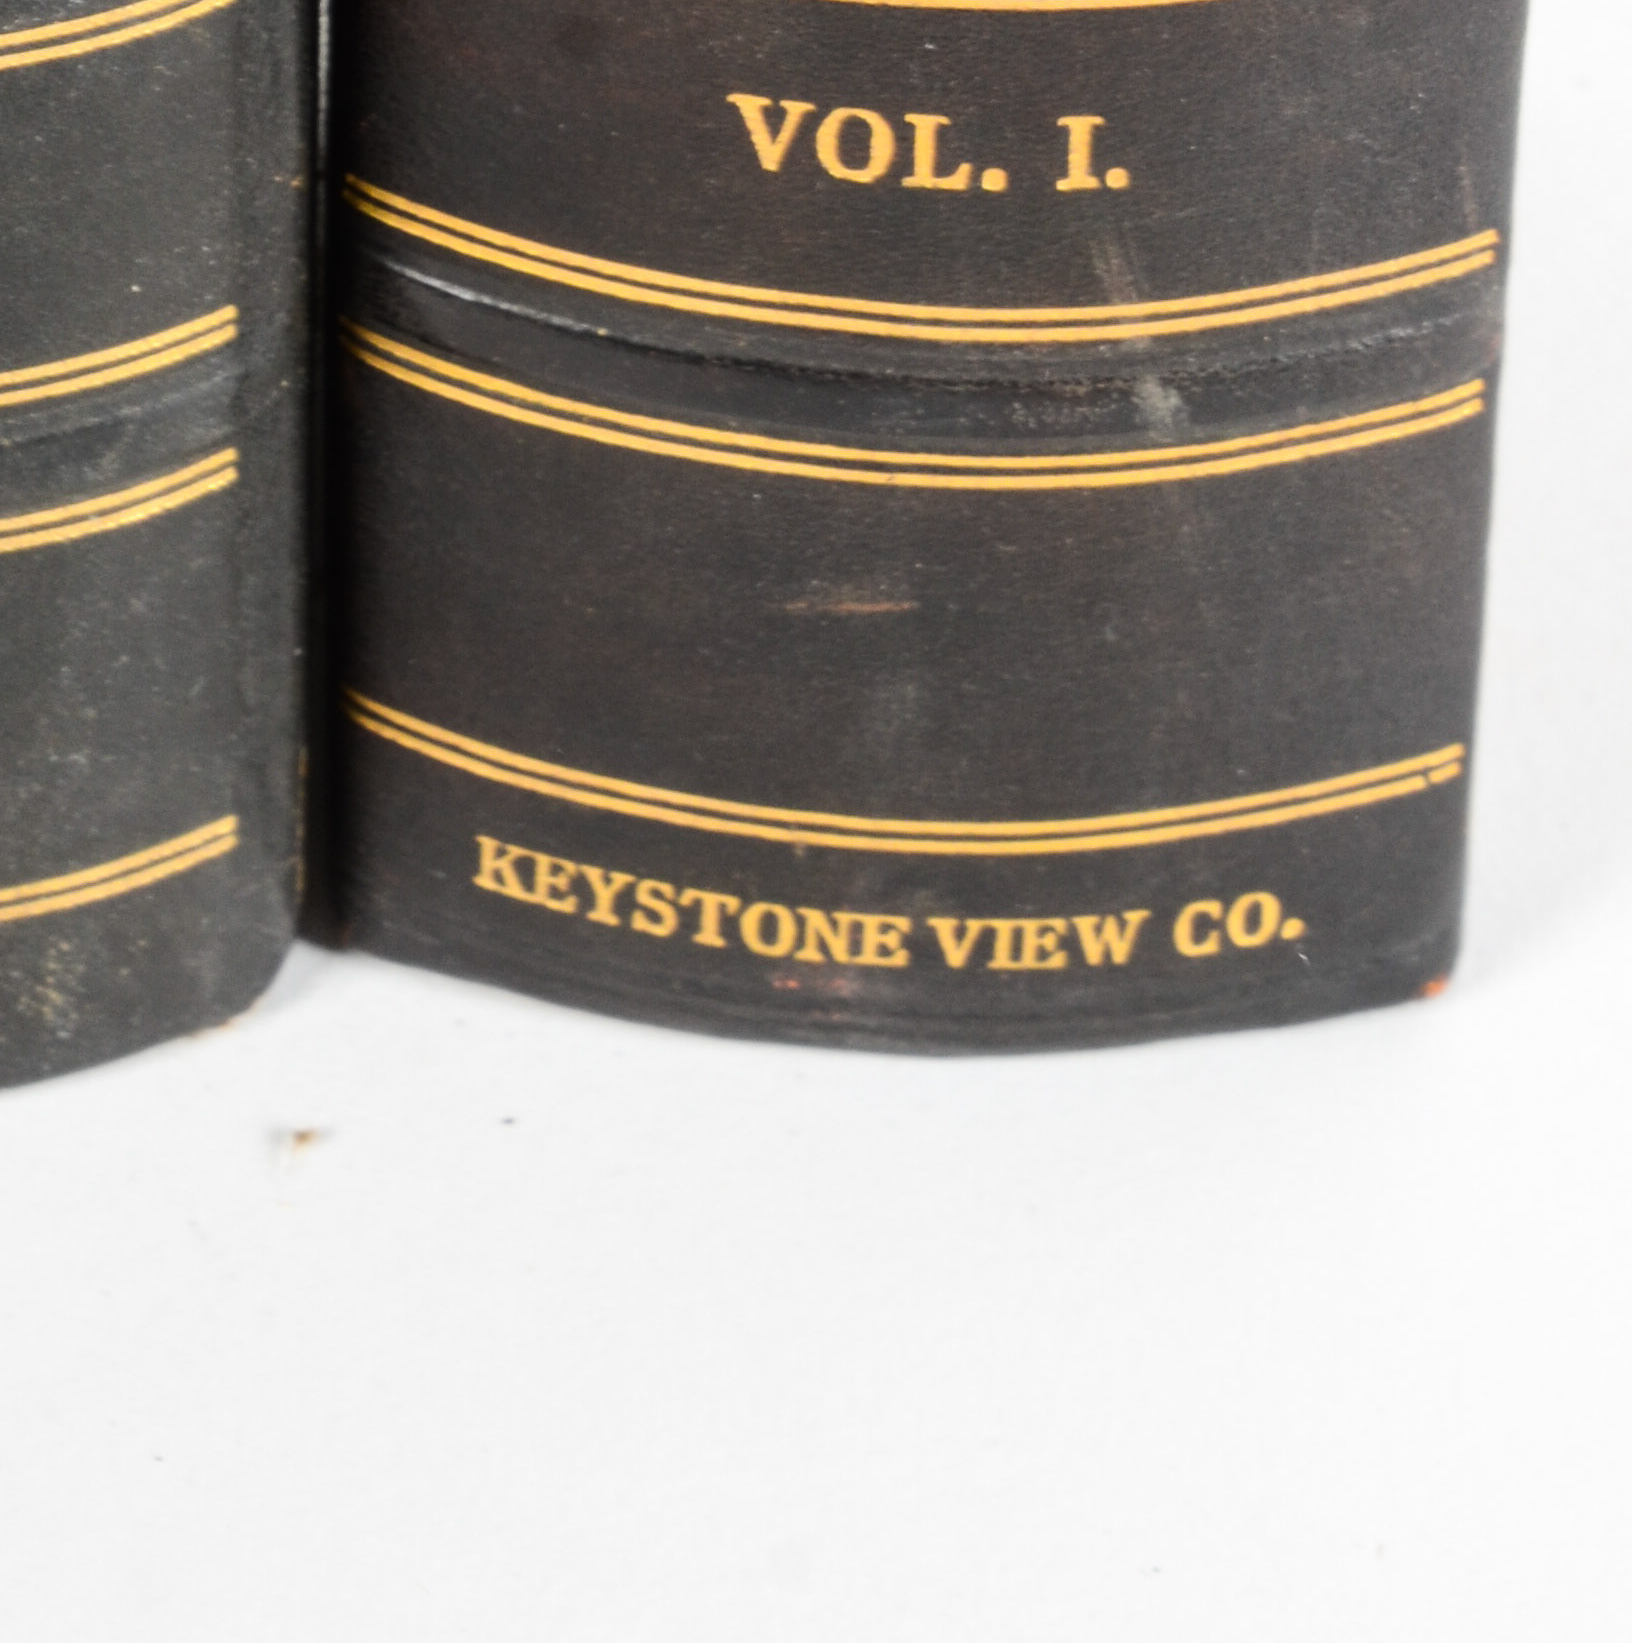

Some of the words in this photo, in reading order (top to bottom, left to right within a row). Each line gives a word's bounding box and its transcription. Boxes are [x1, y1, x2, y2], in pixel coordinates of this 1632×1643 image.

[726, 92, 1009, 193] VOL.
[1054, 115, 1131, 193] I.
[472, 834, 914, 967] KEYSTONE
[926, 909, 1145, 971] VIEW
[1173, 891, 1304, 956] CO.
